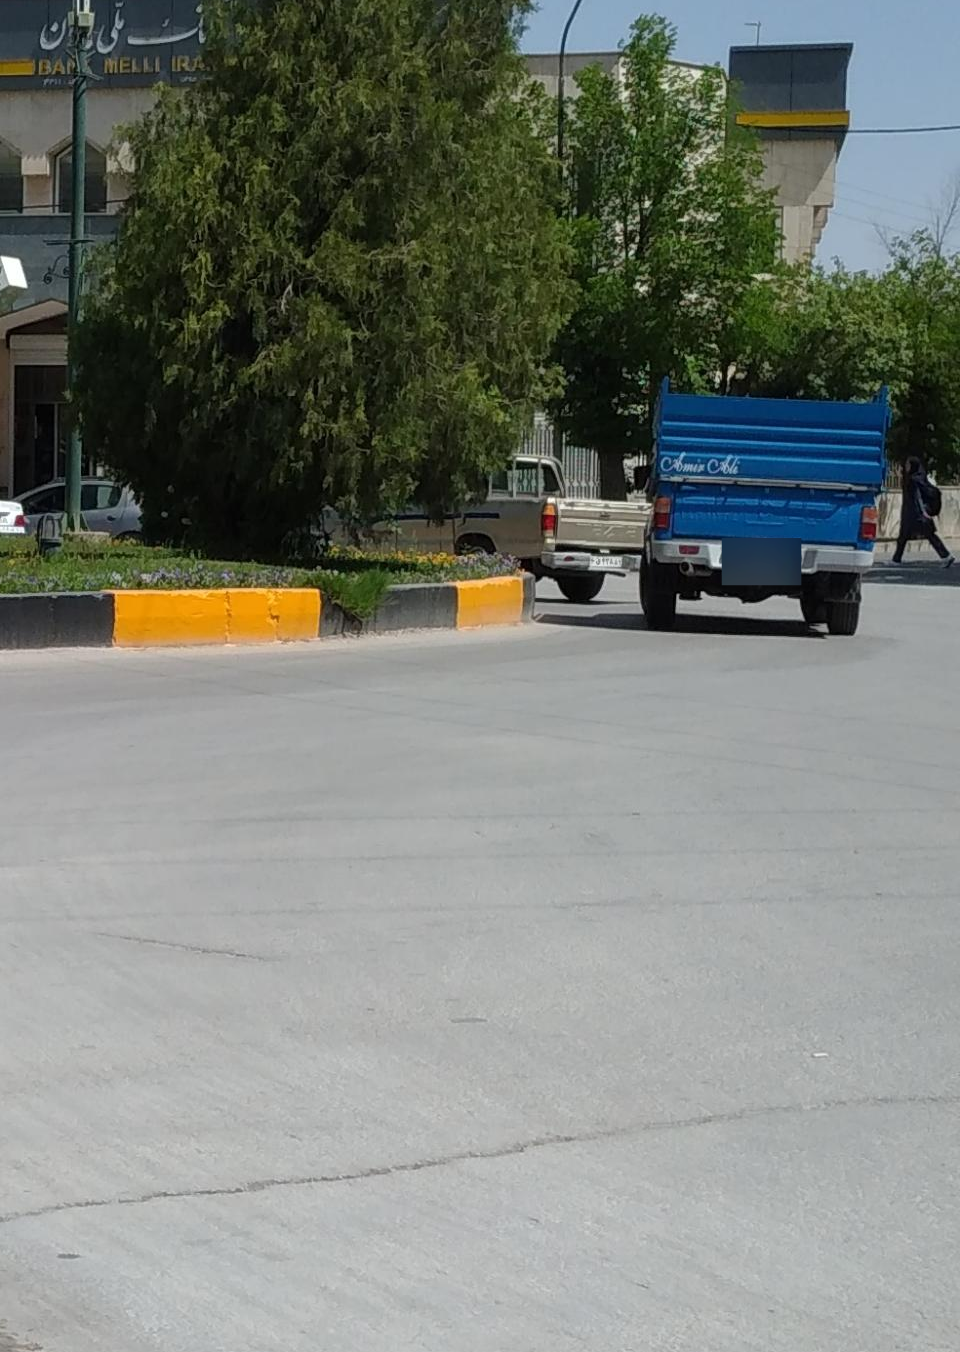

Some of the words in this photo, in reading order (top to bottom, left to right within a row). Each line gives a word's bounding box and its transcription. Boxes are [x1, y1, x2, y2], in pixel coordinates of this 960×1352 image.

[103, 56, 161, 74] MELLI
[660, 451, 705, 473] Amir
[707, 454, 740, 475] Ali
